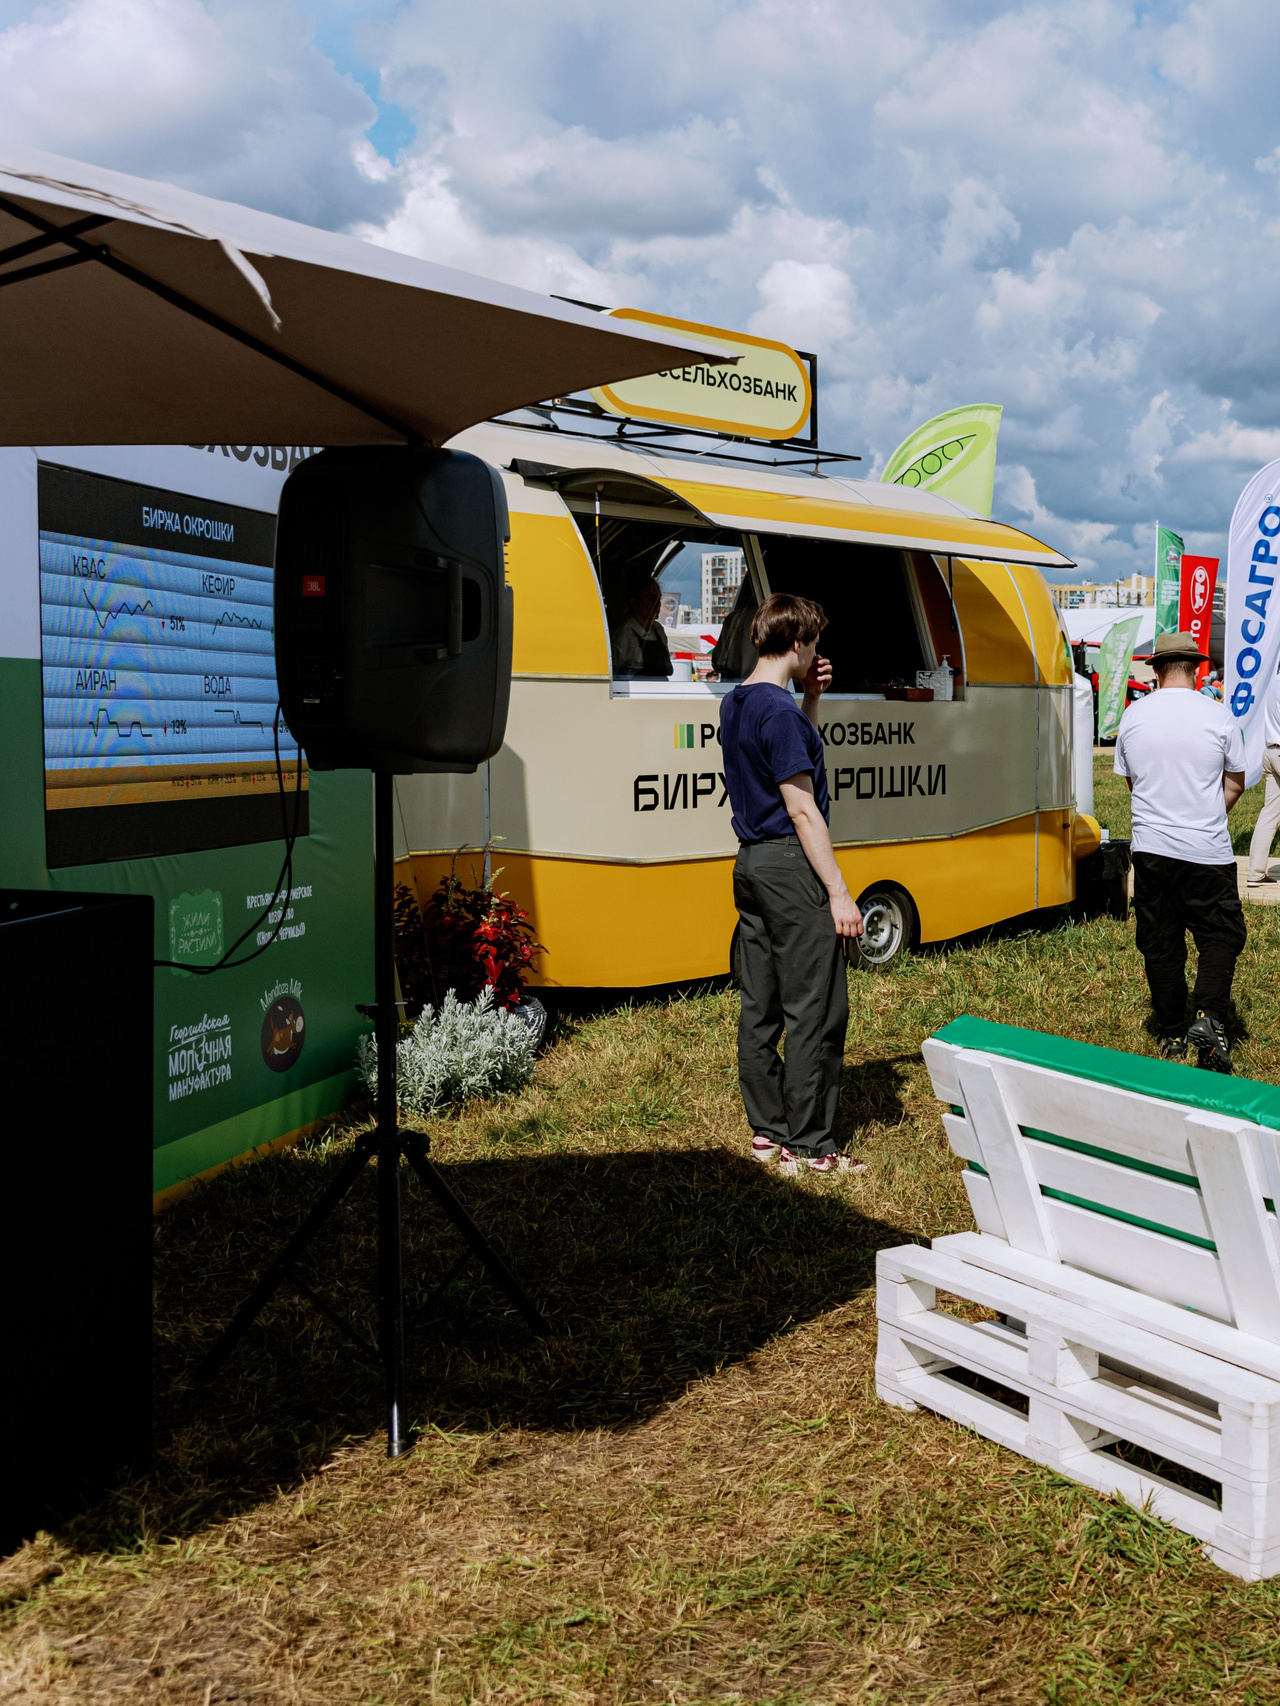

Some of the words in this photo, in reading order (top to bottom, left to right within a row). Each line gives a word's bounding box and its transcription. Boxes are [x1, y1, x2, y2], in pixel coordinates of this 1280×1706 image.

[142, 506, 182, 533] БИРЖА
[183, 514, 235, 543] ОКРОШКИ
[73, 555, 106, 579] КВАС
[202, 574, 235, 596] КЕФИР
[307, 581, 321, 592] JBL
[170, 615, 186, 632] 51%
[75, 666, 117, 691] АЙРАН
[203, 676, 232, 698] ВОДА
[171, 719, 188, 735] 13%
[700, 722, 916, 749] РХОЗБАНК
[633, 772, 731, 812] БИР
[825, 763, 947, 802] РОШКИ
[177, 931, 217, 954] РАСТИЛИ
[260, 979, 289, 1012] Mendoza
[169, 1012, 231, 1044] Георгиевская
[168, 1062, 232, 1102] МАНУФАКТУРА
